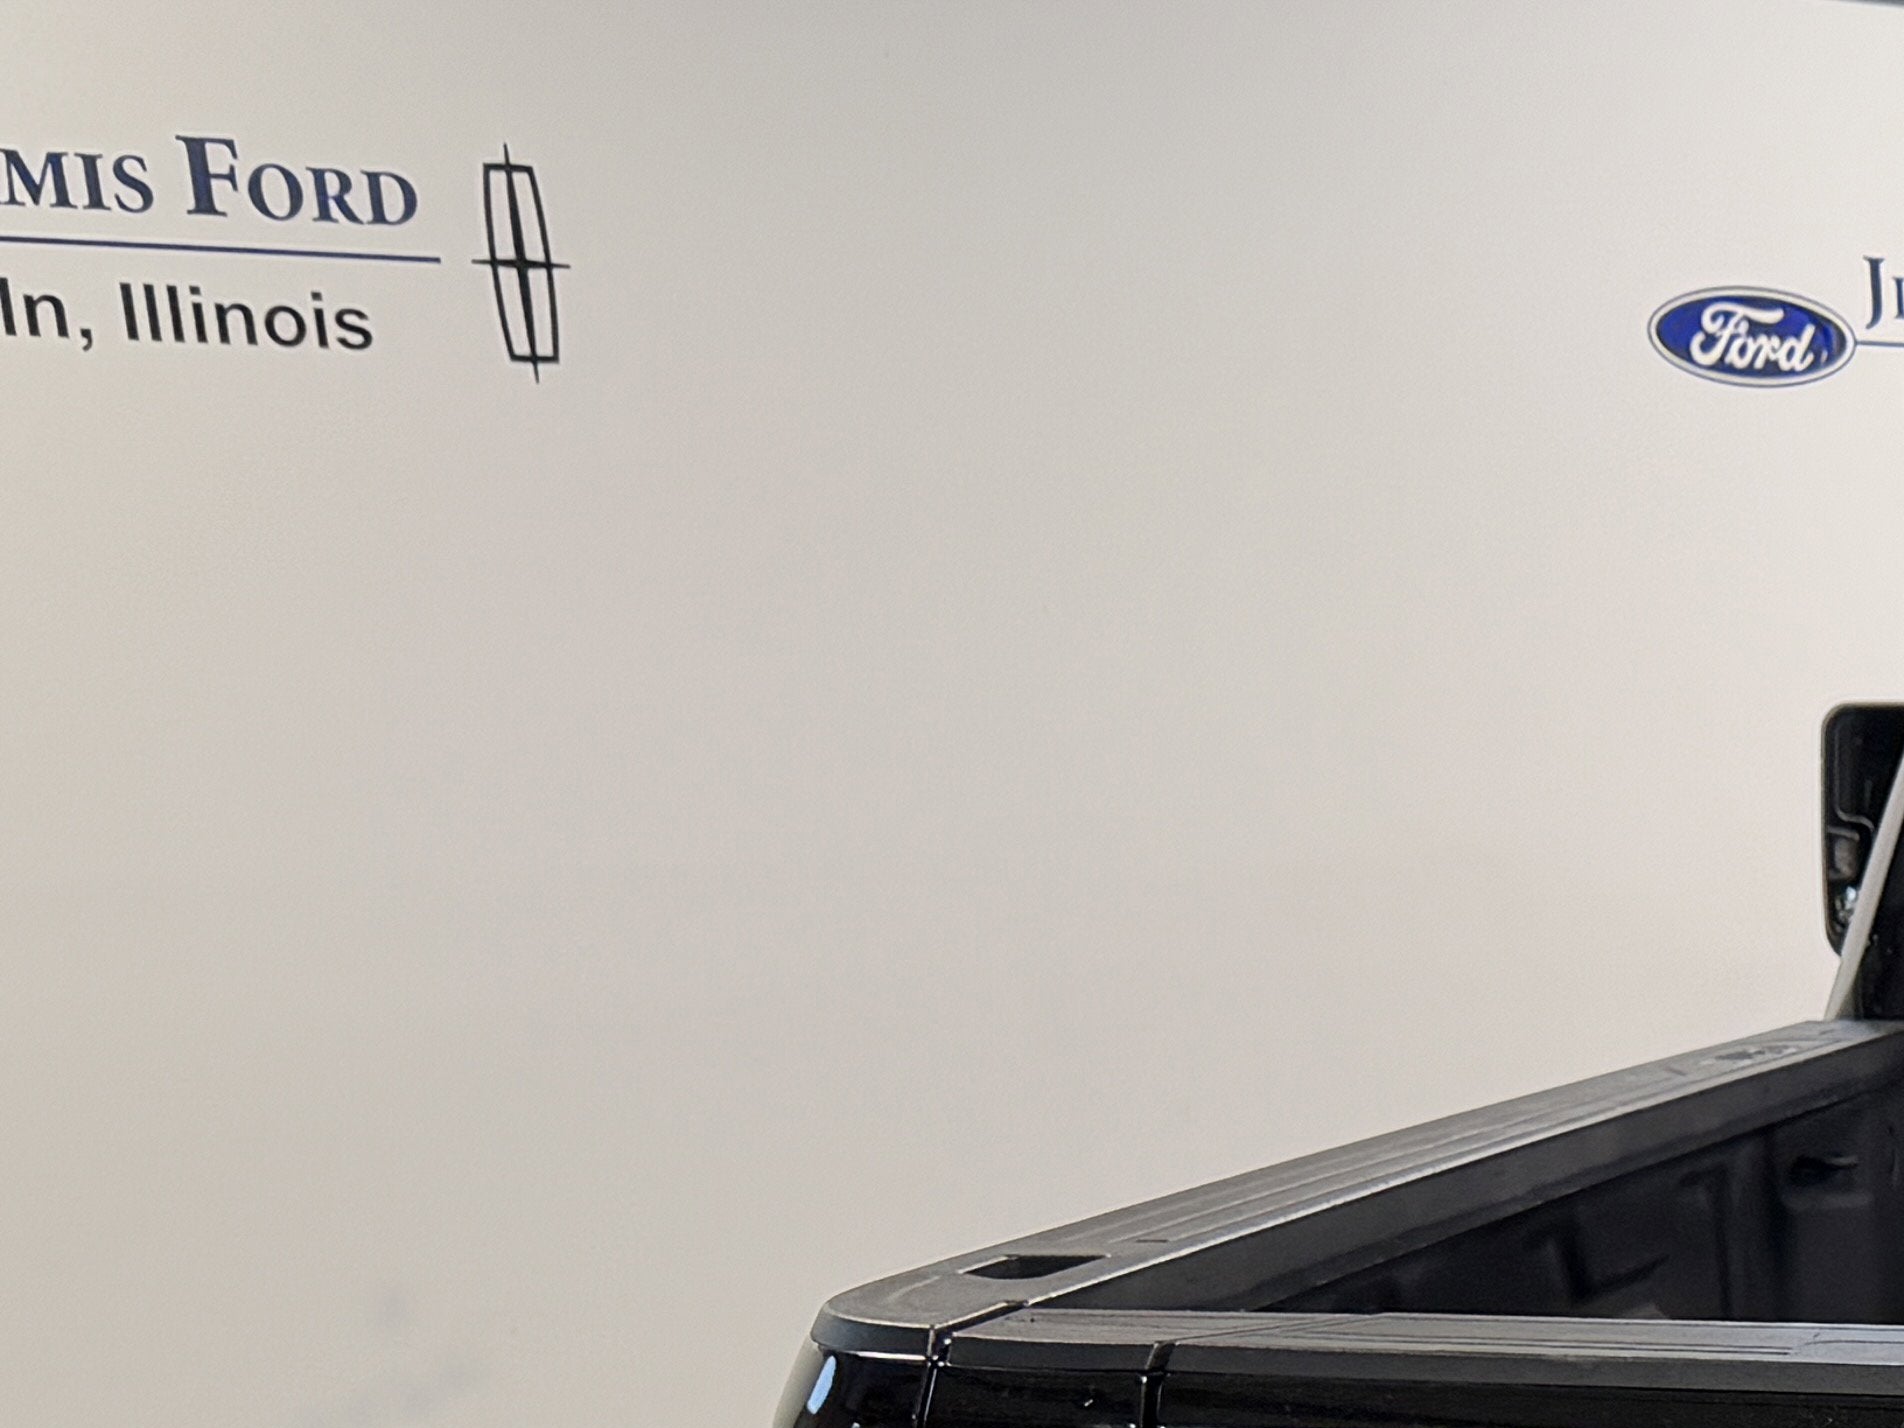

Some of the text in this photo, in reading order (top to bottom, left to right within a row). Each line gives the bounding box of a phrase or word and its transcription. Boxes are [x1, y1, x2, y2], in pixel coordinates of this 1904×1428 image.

[175, 135, 418, 225] FORD
[120, 283, 373, 351] Illinois
[1690, 304, 1814, 372] Ford
